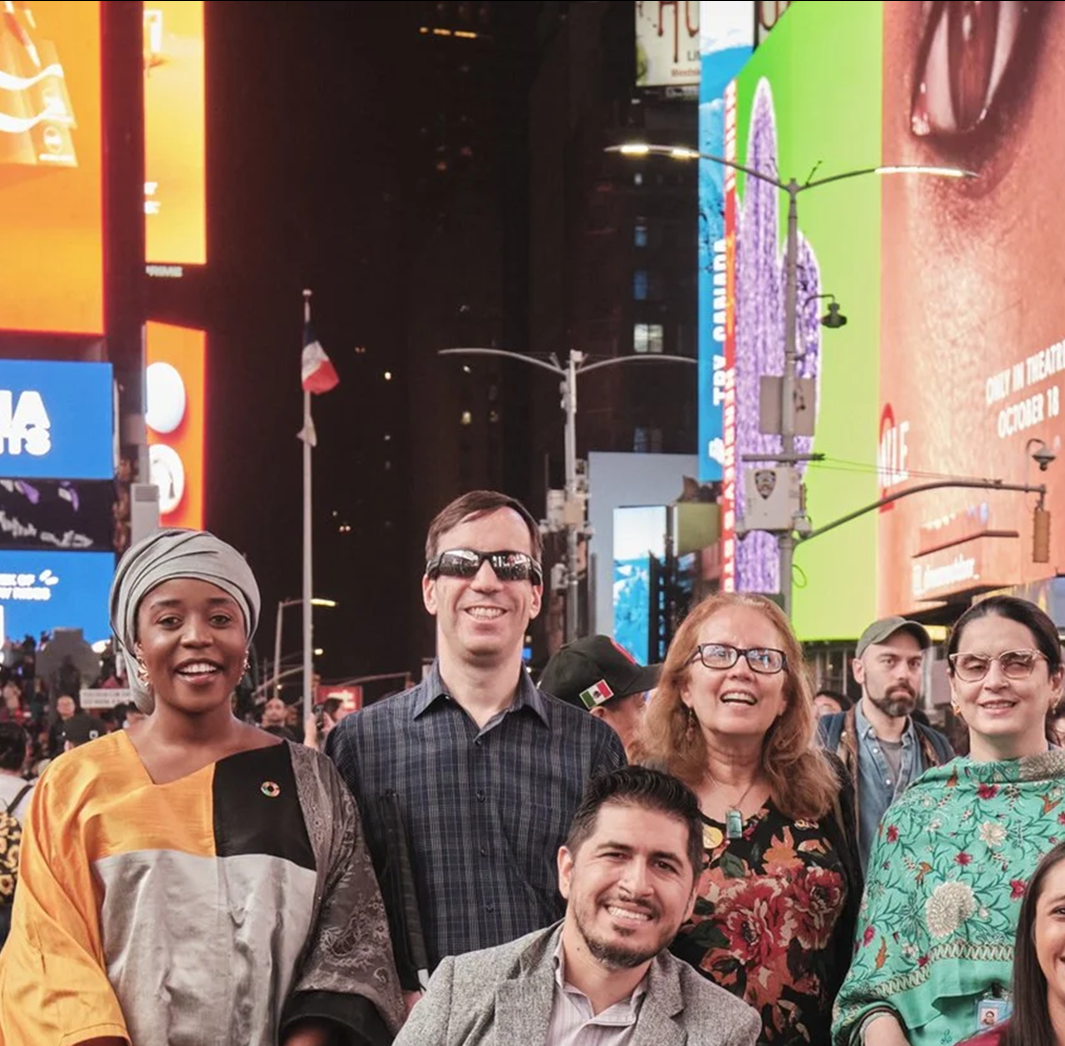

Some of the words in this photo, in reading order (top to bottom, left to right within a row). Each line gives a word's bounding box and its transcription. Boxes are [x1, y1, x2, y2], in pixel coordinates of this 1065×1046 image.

[986, 369, 1010, 405] ONLY
[1012, 361, 1025, 392] IN
[998, 393, 1044, 438] OCTOBER
[1047, 385, 1060, 418] 18
